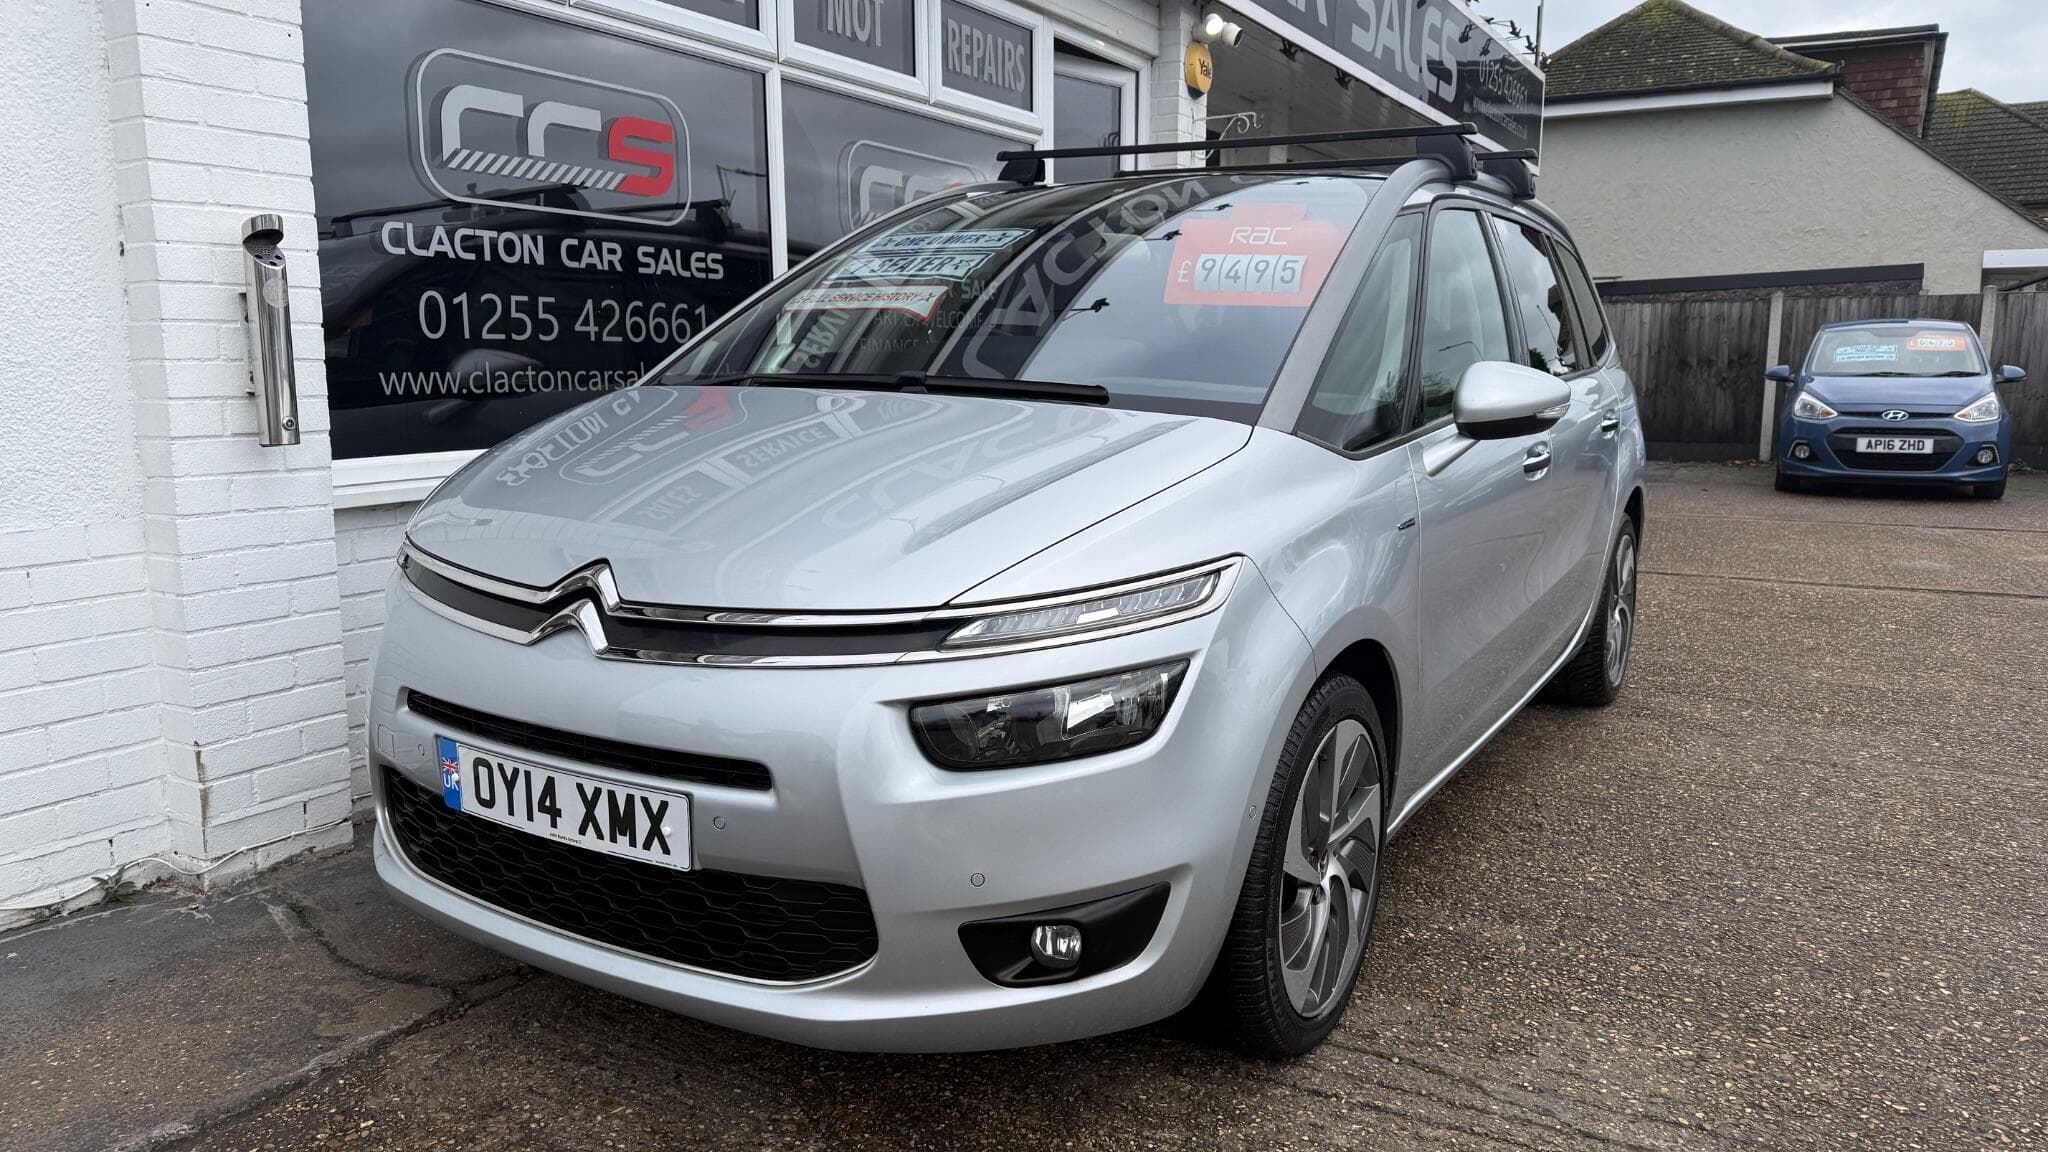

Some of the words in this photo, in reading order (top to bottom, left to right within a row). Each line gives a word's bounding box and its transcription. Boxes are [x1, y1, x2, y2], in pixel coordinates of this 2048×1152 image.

[827, 0, 884, 47] MOT
[947, 18, 1026, 92] REPAIRS
[441, 85, 675, 198] CCS
[381, 221, 545, 266] CLACTON
[560, 238, 623, 272] CAR
[637, 246, 724, 280] SALES
[869, 256, 956, 274] SEATER
[418, 290, 559, 341] 01255
[574, 298, 708, 344] 426661
[1865, 439, 1895, 451] AP16
[1898, 439, 1926, 451] ZHD
[472, 756, 562, 829] OY14
[575, 782, 671, 856] XMX
